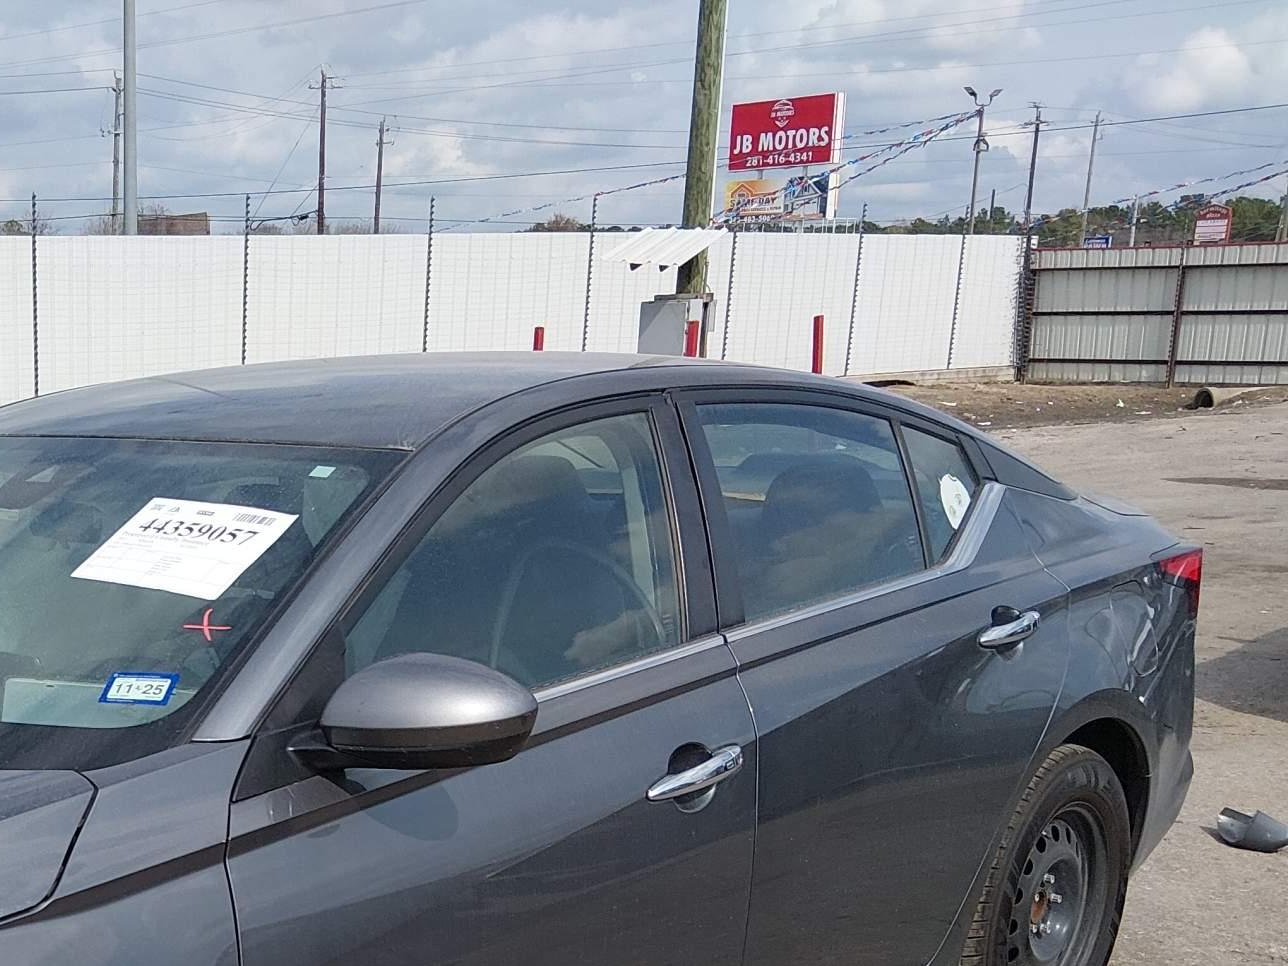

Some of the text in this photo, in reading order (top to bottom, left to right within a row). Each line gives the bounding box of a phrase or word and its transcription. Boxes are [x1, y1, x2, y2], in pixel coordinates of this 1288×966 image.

[734, 126, 829, 154] JB MOTORS
[746, 152, 813, 167] 281-416-4341
[139, 518, 261, 545] 44359057
